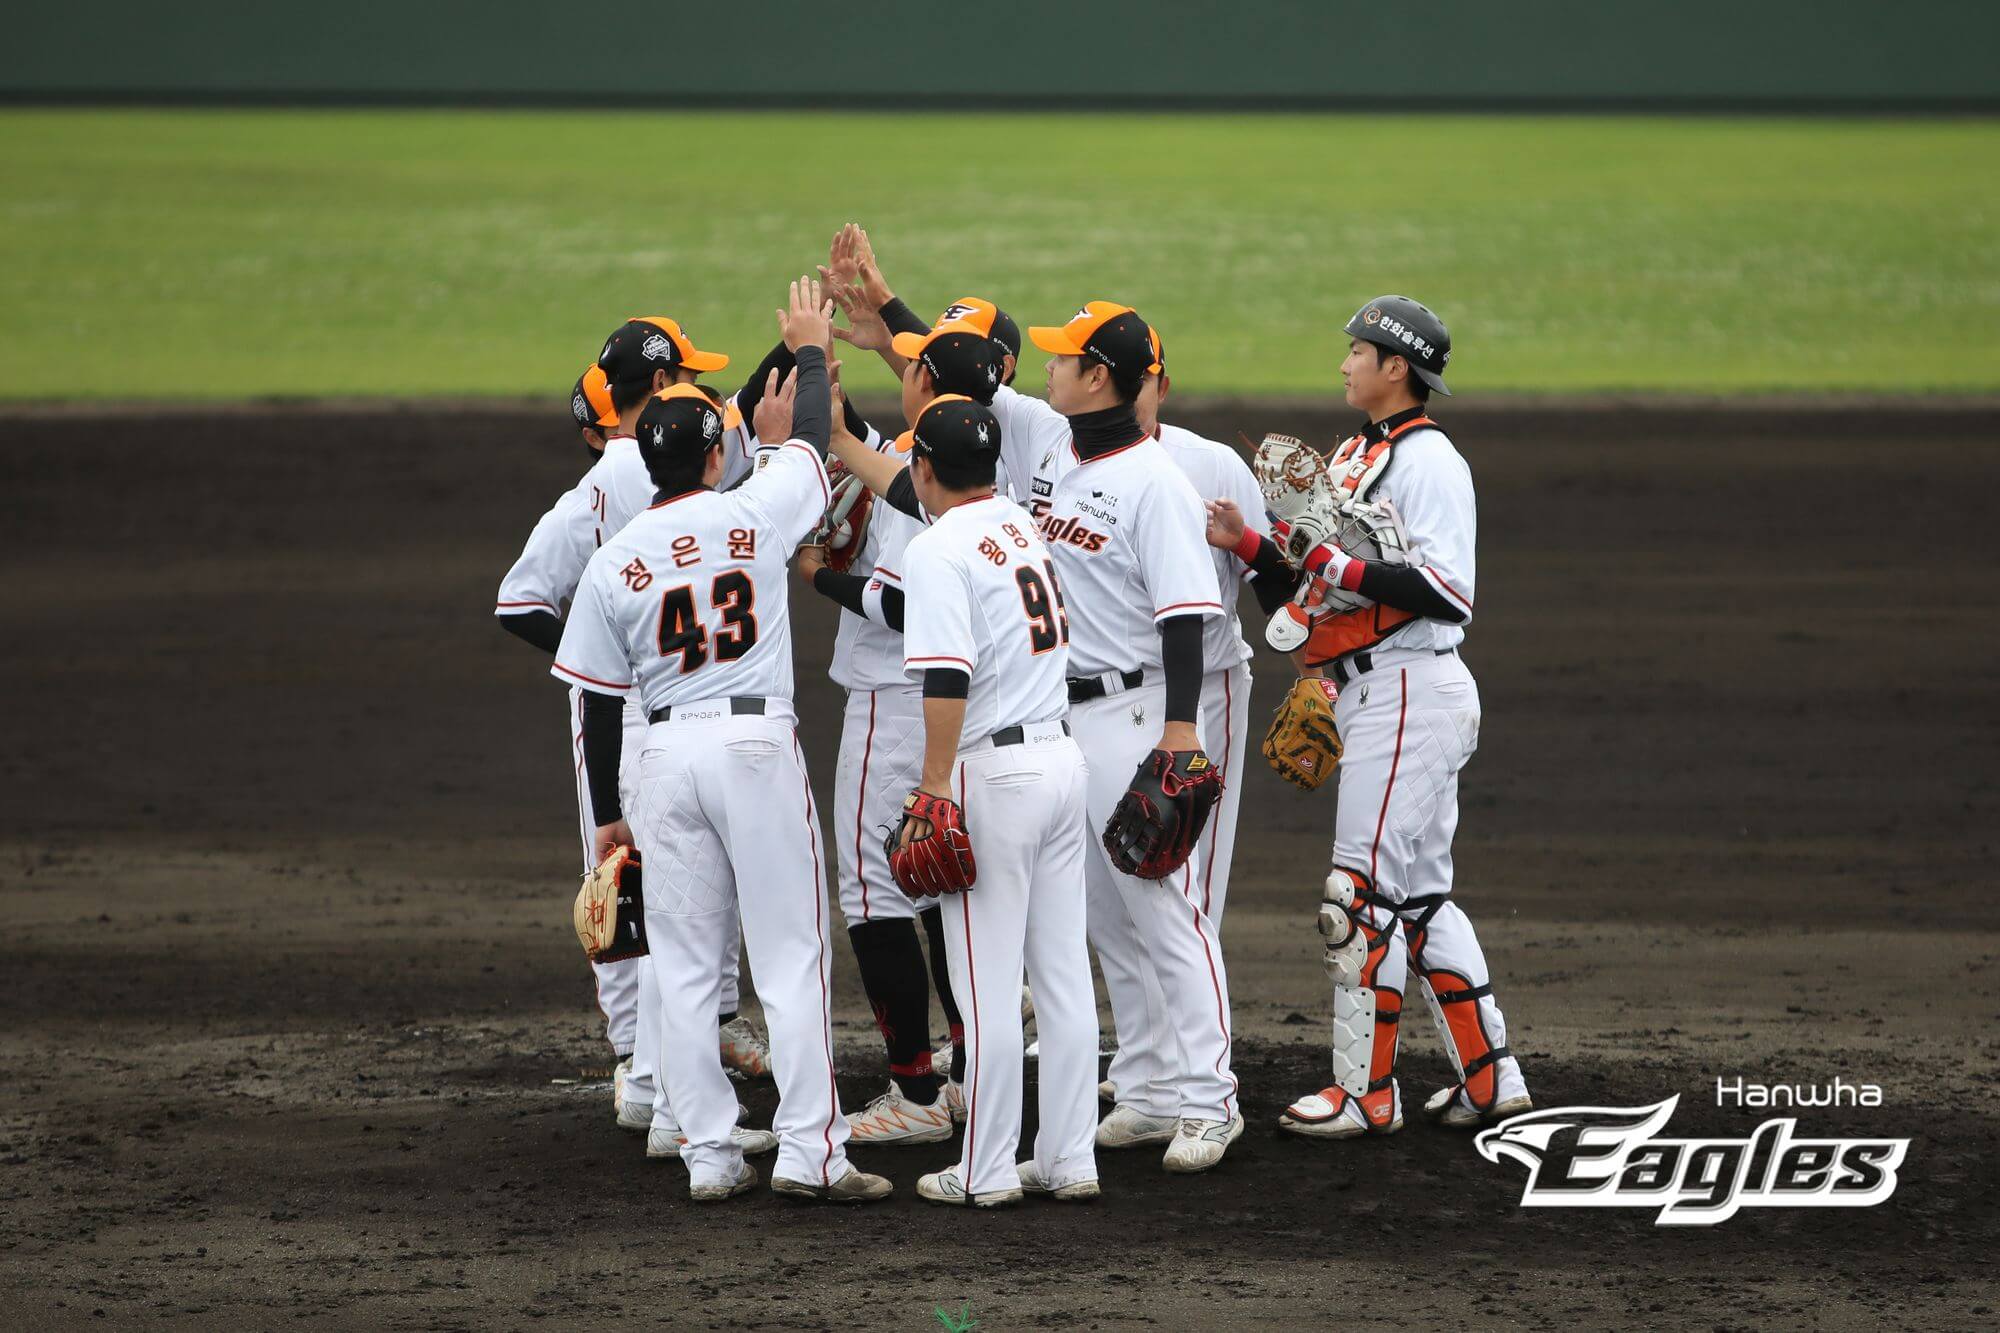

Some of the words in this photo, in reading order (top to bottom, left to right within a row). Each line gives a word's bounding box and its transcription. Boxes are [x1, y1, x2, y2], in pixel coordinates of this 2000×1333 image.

[1379, 315, 1435, 360] 한화솔루션
[923, 353, 940, 379] SPYDER
[1089, 345, 1116, 368] SPYDER
[1074, 500, 1117, 525] Hanwha
[977, 520, 1041, 567] 황영
[656, 569, 759, 675] 43
[680, 711, 721, 720] SPYDER
[1033, 734, 1060, 744] SPYDER
